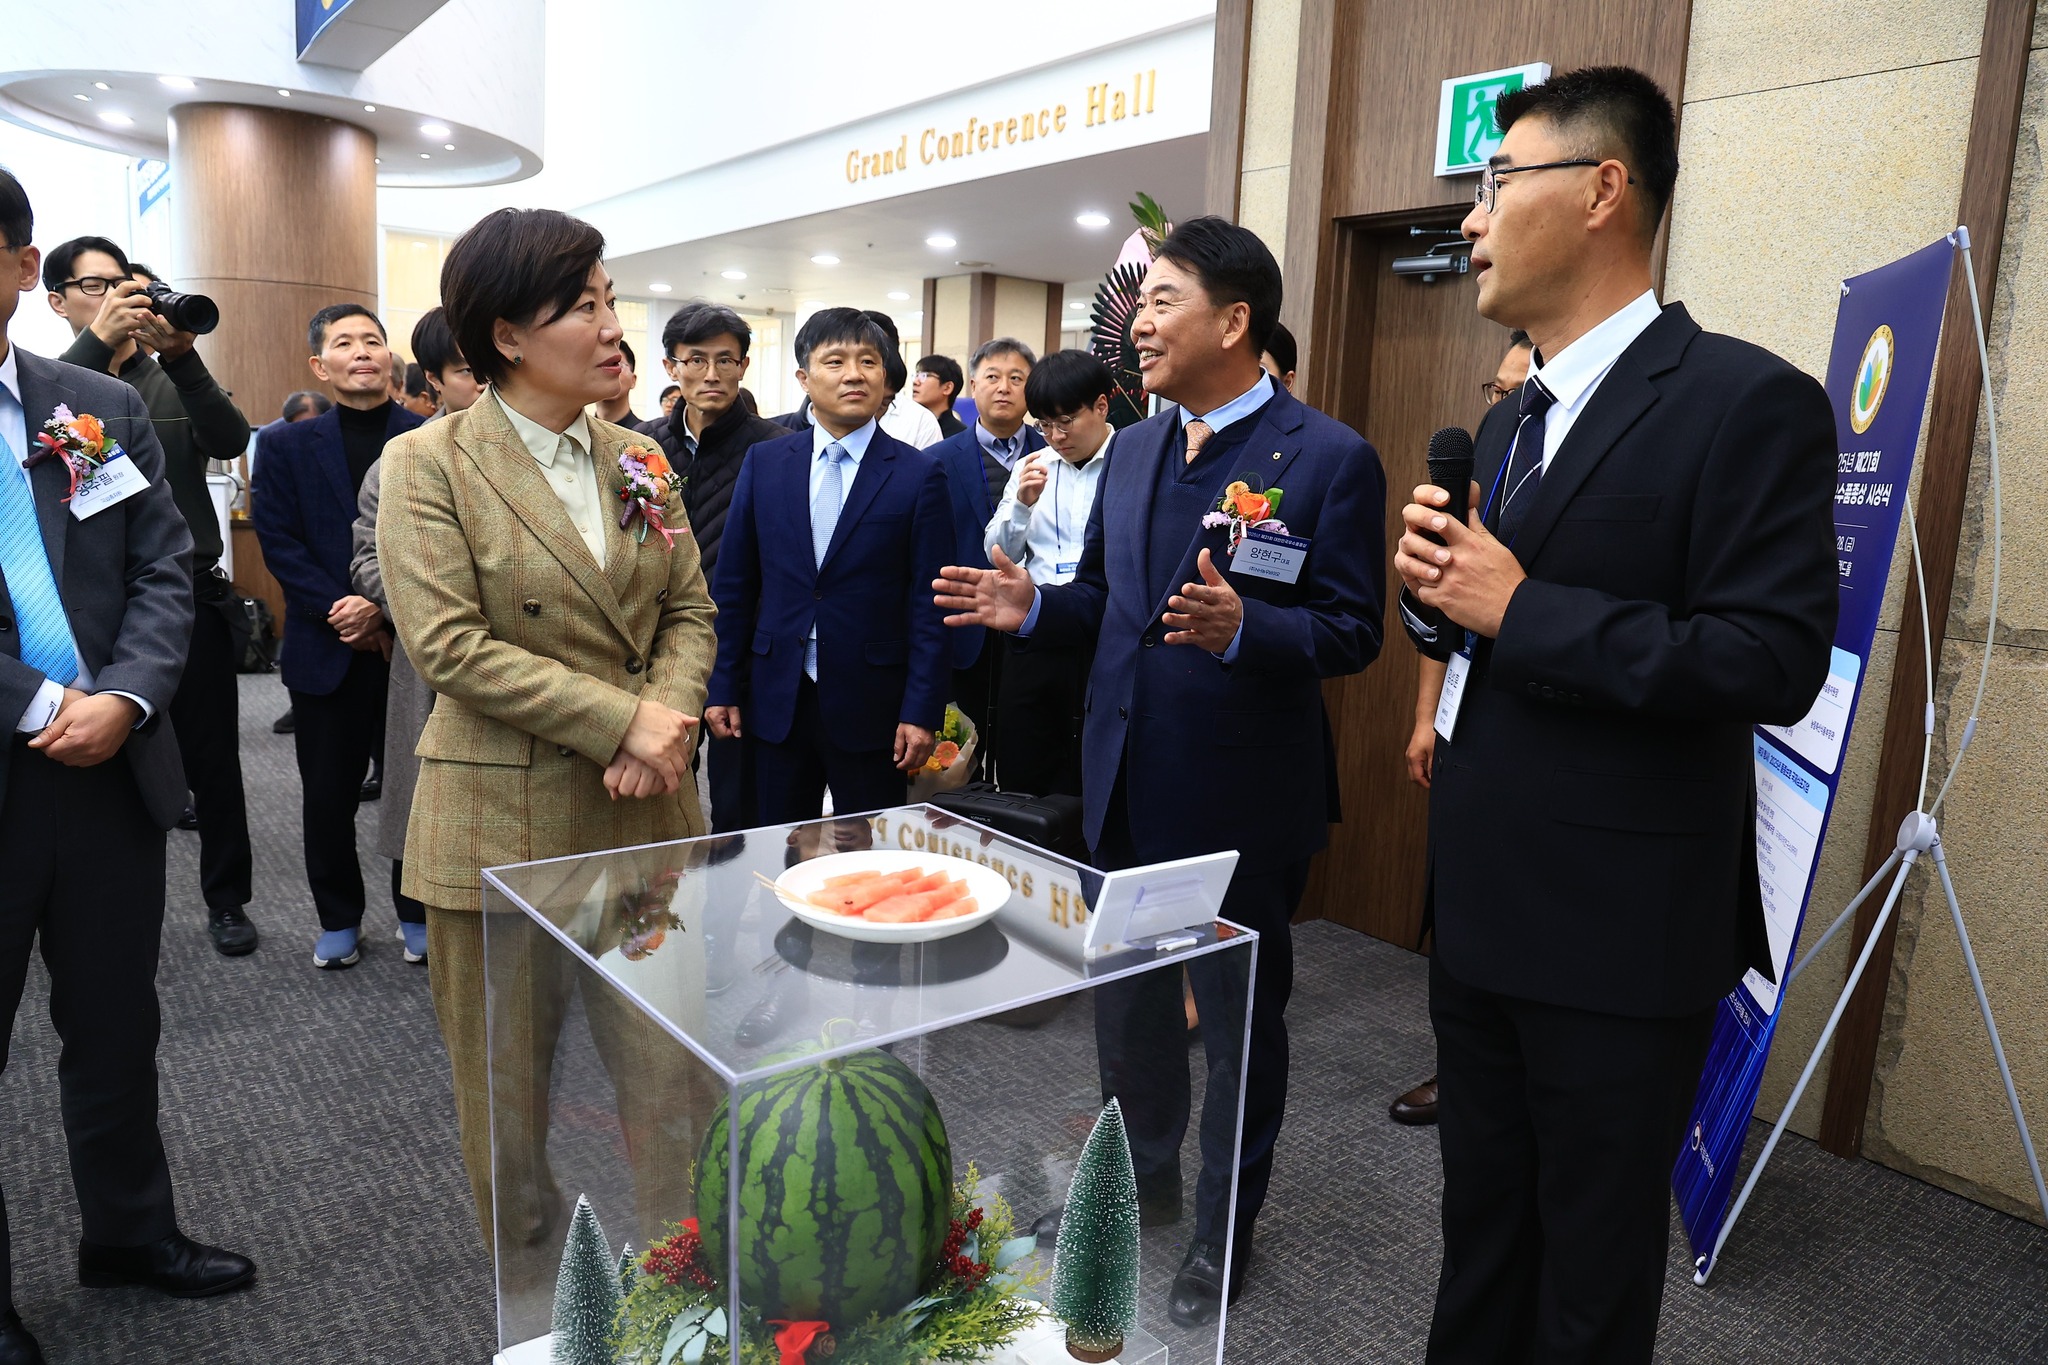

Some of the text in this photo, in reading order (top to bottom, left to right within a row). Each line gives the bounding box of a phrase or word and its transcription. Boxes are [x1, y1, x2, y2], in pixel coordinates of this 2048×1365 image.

[845, 69, 1157, 184] Grand Conference Hall
[1854, 450, 1882, 473] 제21회
[1865, 483, 1893, 507] 시상식
[1250, 546, 1291, 566] 양현구 대표
